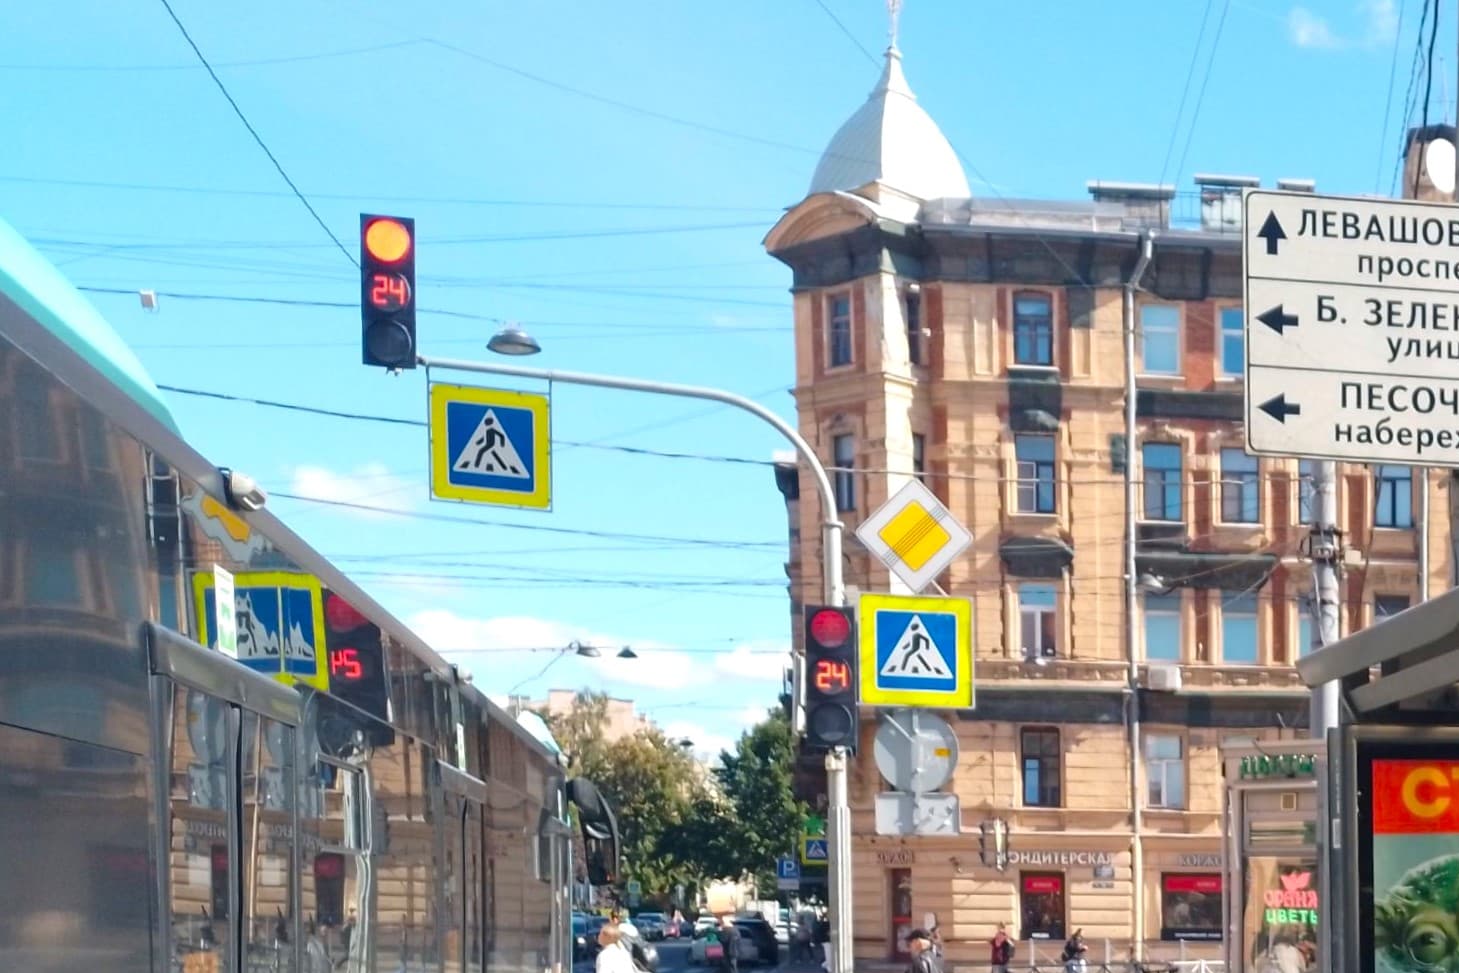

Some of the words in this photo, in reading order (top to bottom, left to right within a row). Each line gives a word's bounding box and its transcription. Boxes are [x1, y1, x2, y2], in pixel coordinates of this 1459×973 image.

[373, 275, 406, 306] 24
[1317, 296, 1347, 324] Б.
[815, 661, 848, 690] 24
